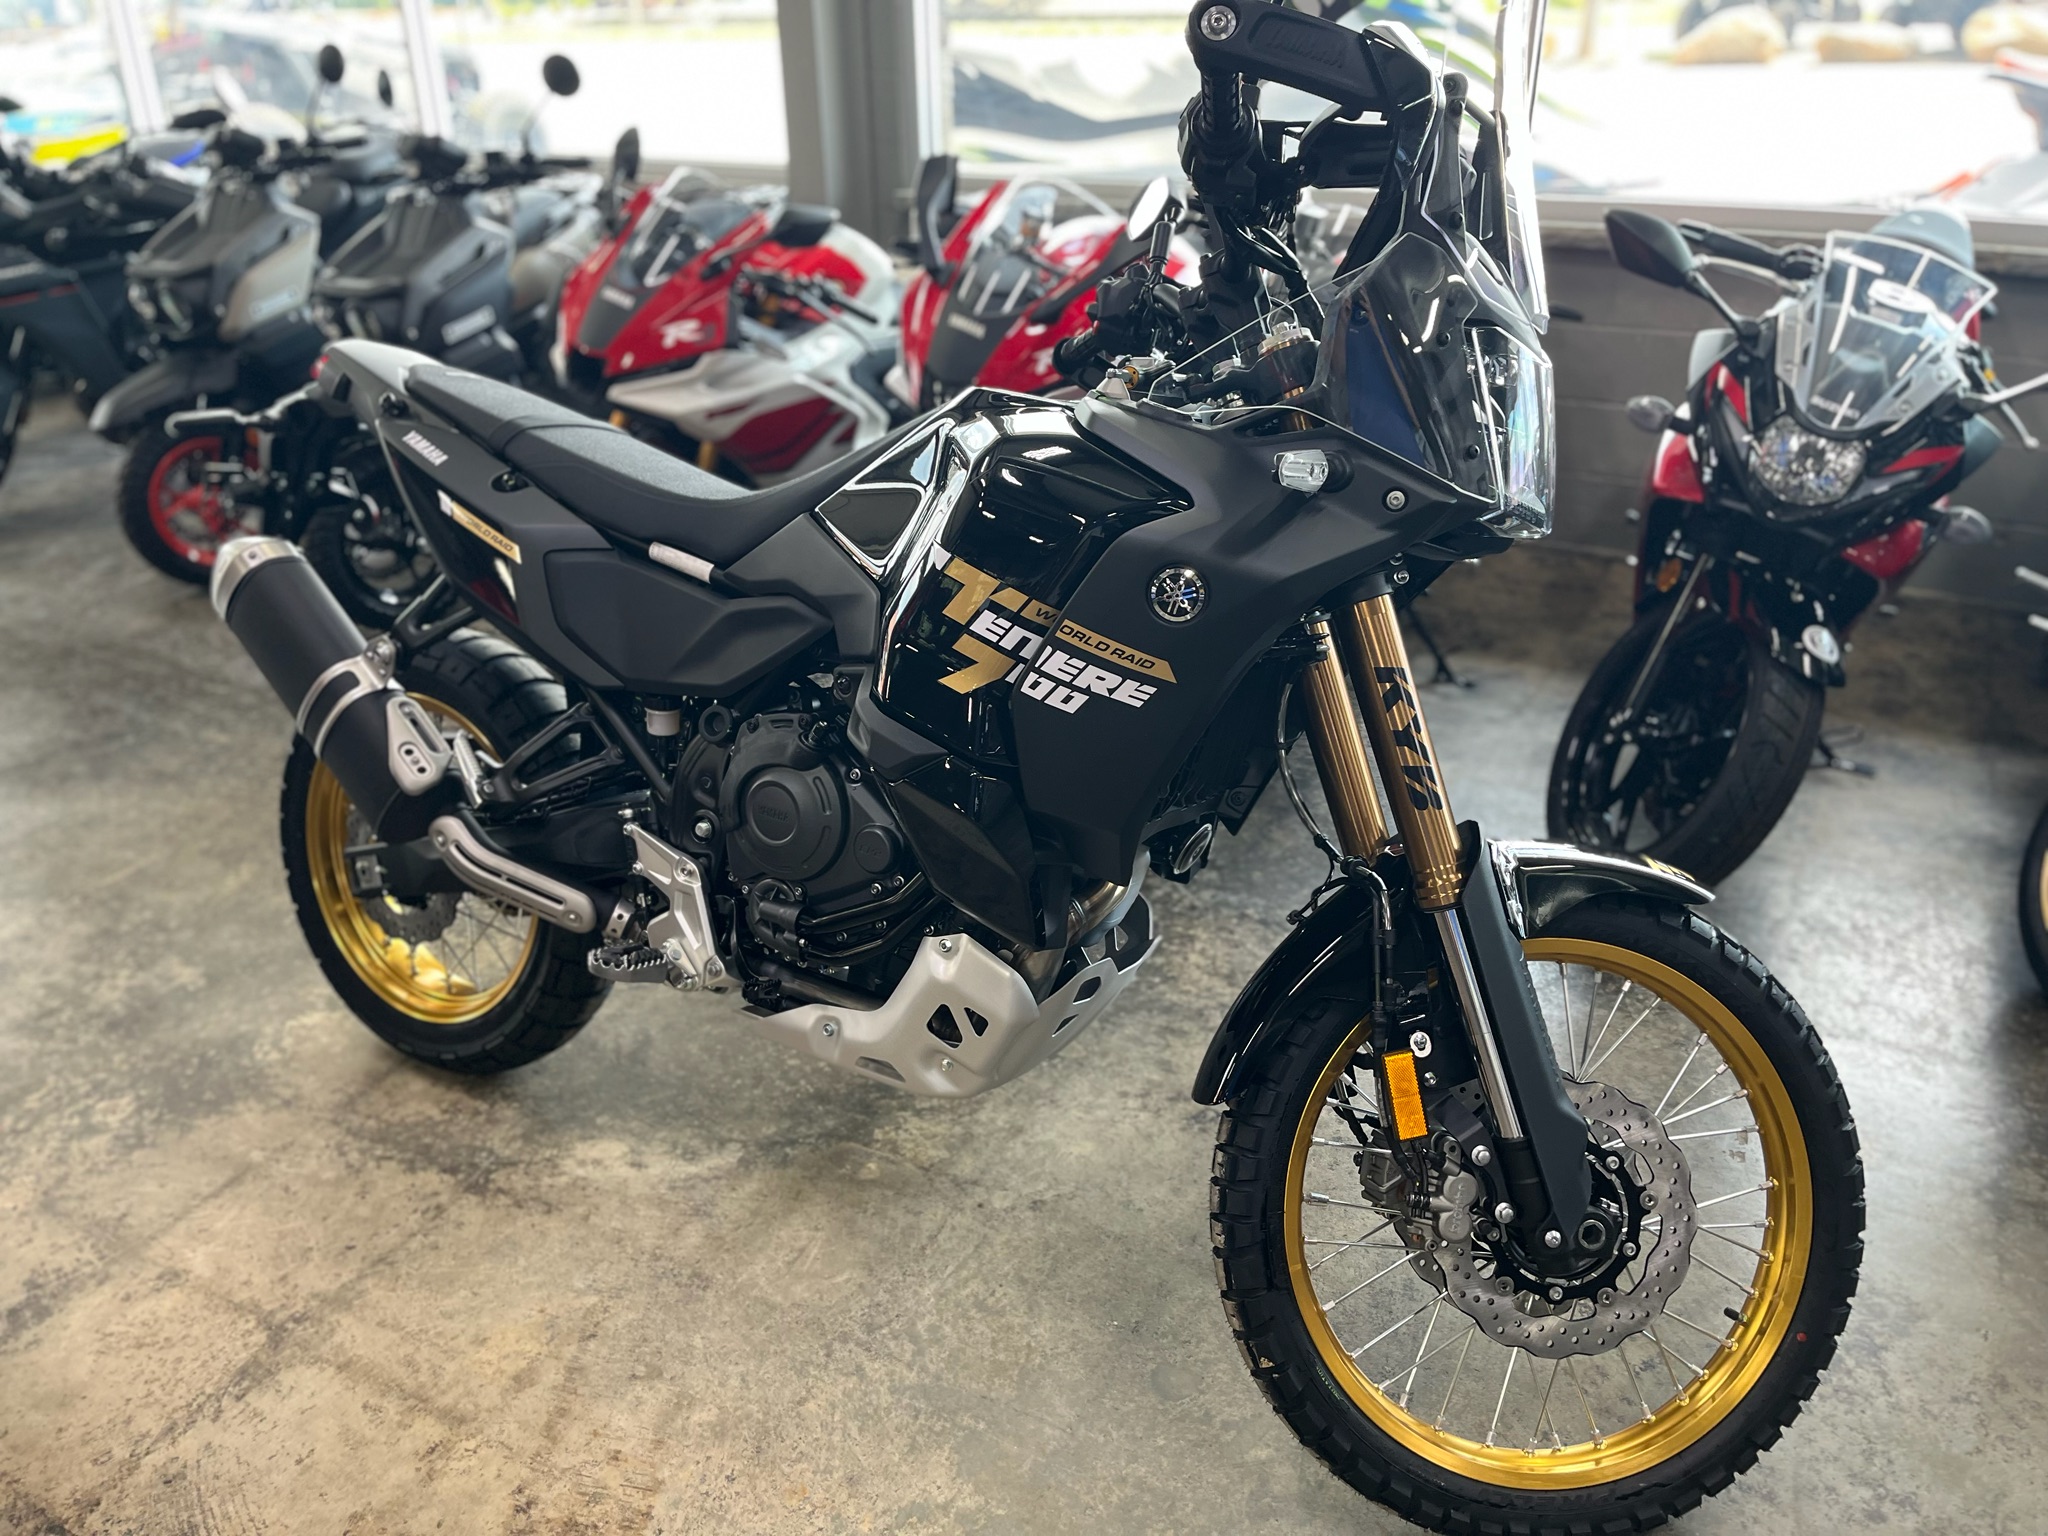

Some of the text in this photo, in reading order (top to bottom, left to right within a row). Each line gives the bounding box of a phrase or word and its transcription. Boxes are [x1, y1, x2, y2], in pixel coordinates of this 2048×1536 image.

[402, 430, 449, 466] YAMAHA
[490, 534, 514, 552] RAID
[1036, 607, 1156, 669] WORLD RAID
[1373, 666, 1443, 811] KYB
